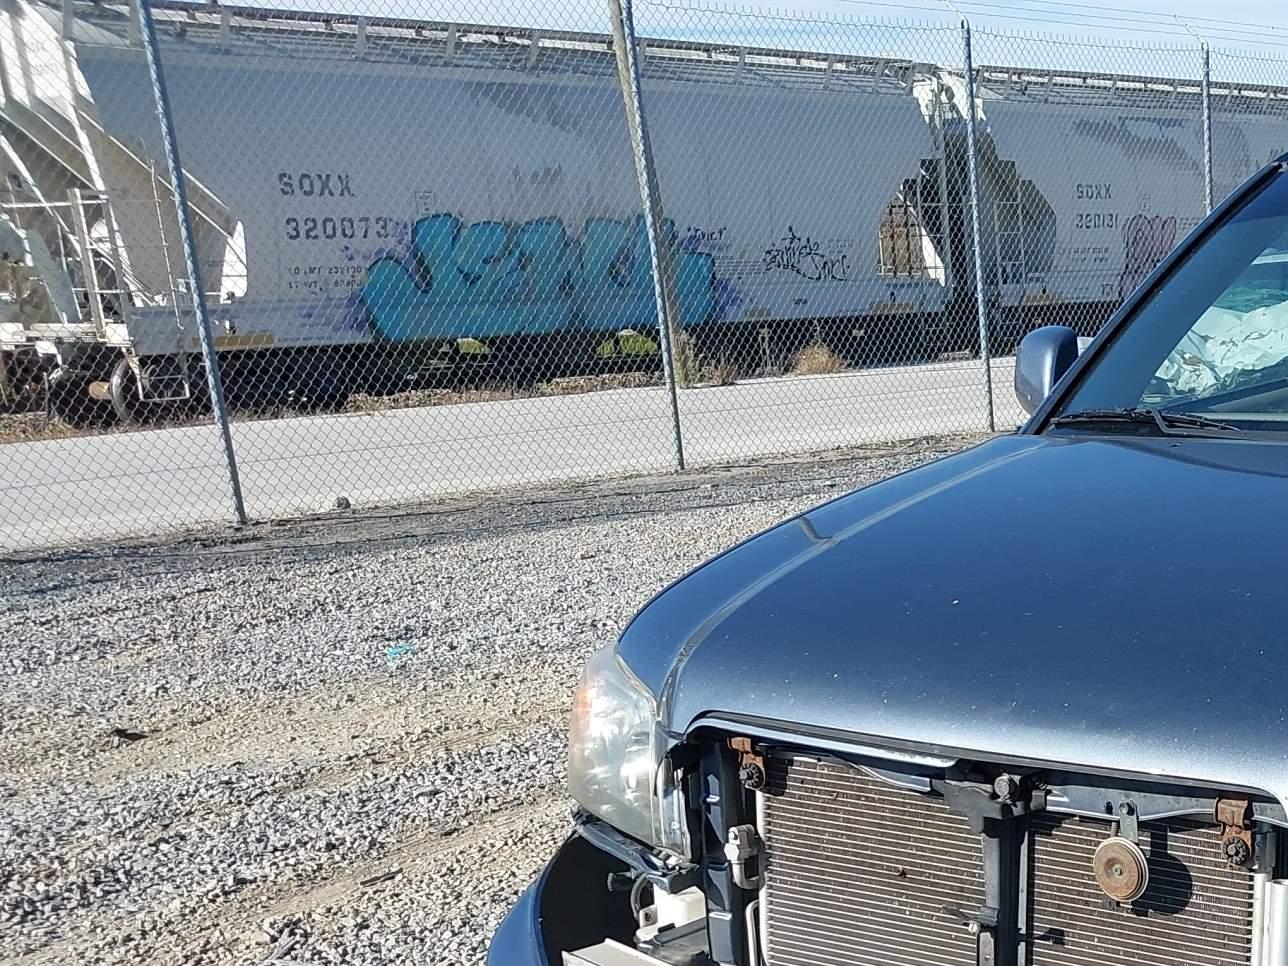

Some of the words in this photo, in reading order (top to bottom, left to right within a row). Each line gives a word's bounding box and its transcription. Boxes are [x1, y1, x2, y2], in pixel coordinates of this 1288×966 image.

[278, 172, 355, 197] SOXX
[1075, 183, 1113, 200] SOXX
[285, 216, 389, 240] 320073
